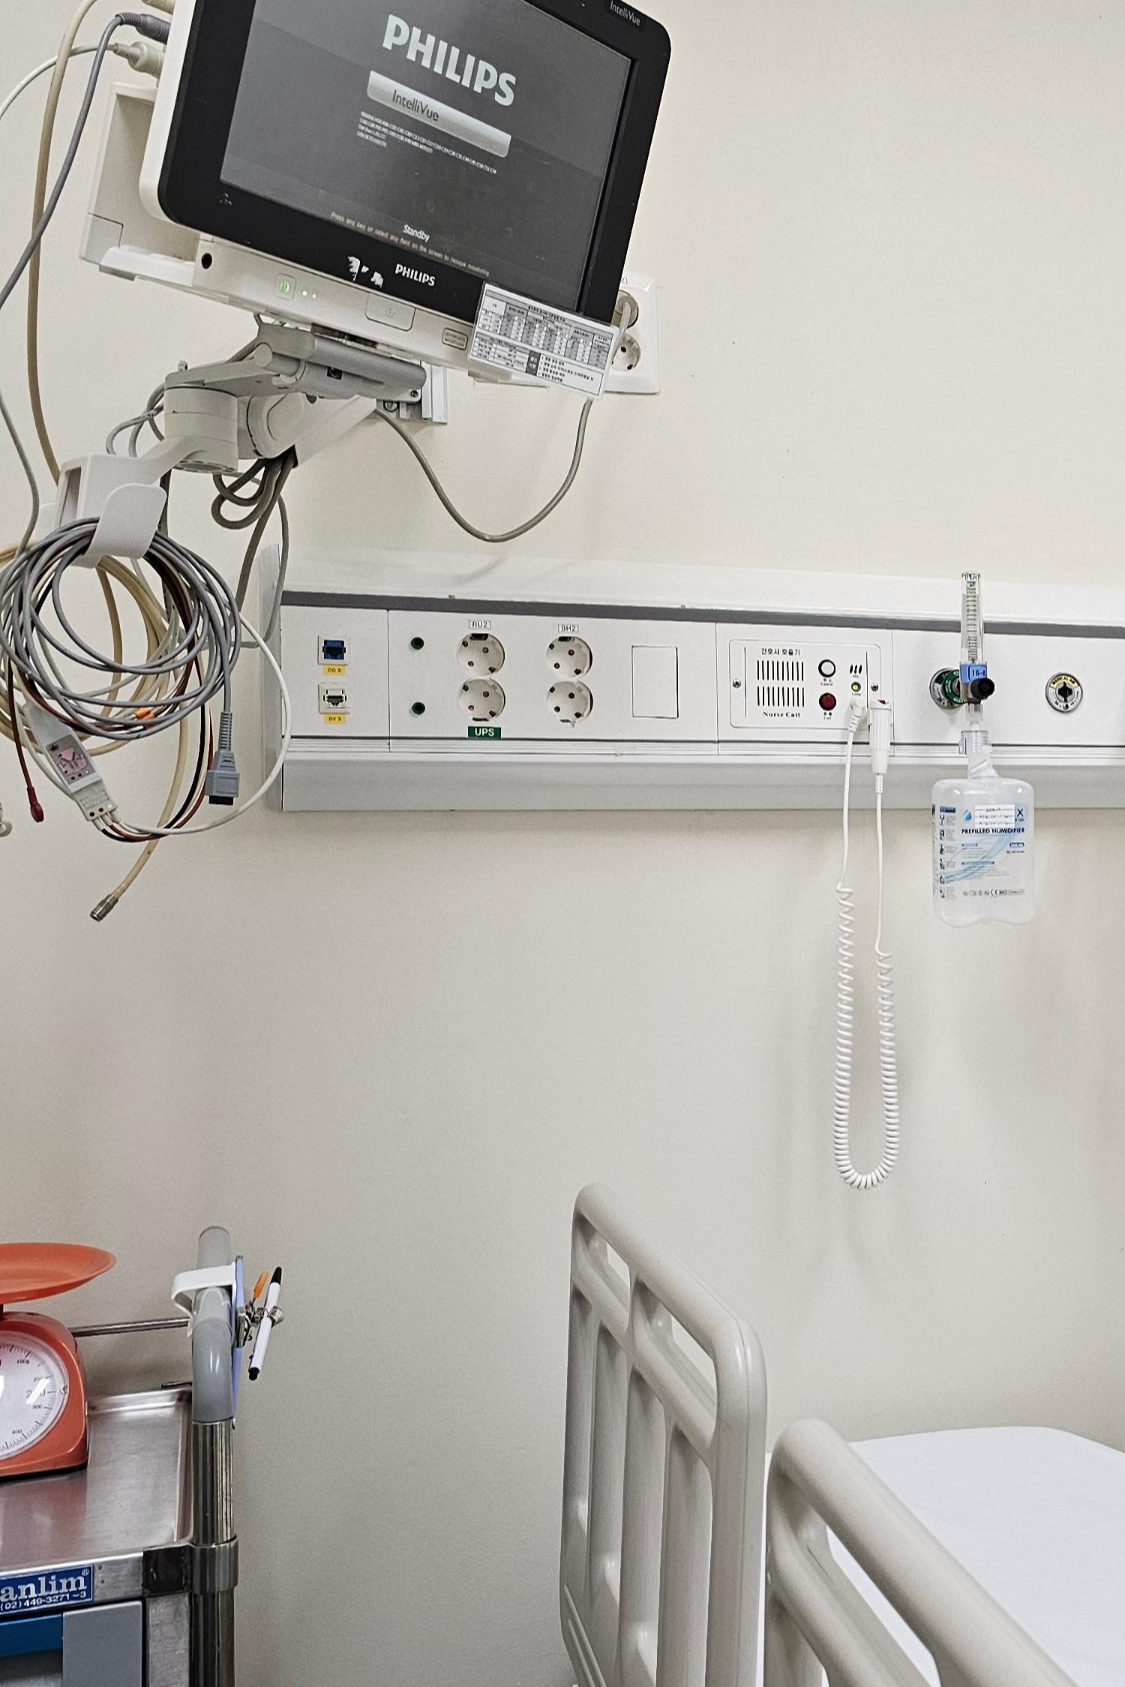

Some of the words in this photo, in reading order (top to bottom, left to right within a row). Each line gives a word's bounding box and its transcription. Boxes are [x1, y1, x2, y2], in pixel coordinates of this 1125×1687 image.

[610, 1, 641, 26] IntelliVue
[382, 14, 517, 106] PHILIPS
[392, 89, 440, 122] IntelliVue
[403, 224, 430, 243] Standby
[395, 263, 436, 287] PHILIPS
[761, 648, 780, 656] 간호사
[782, 648, 801, 656] 호출기
[474, 727, 495, 737] UPS
[0, 1575, 87, 1602] anlim
